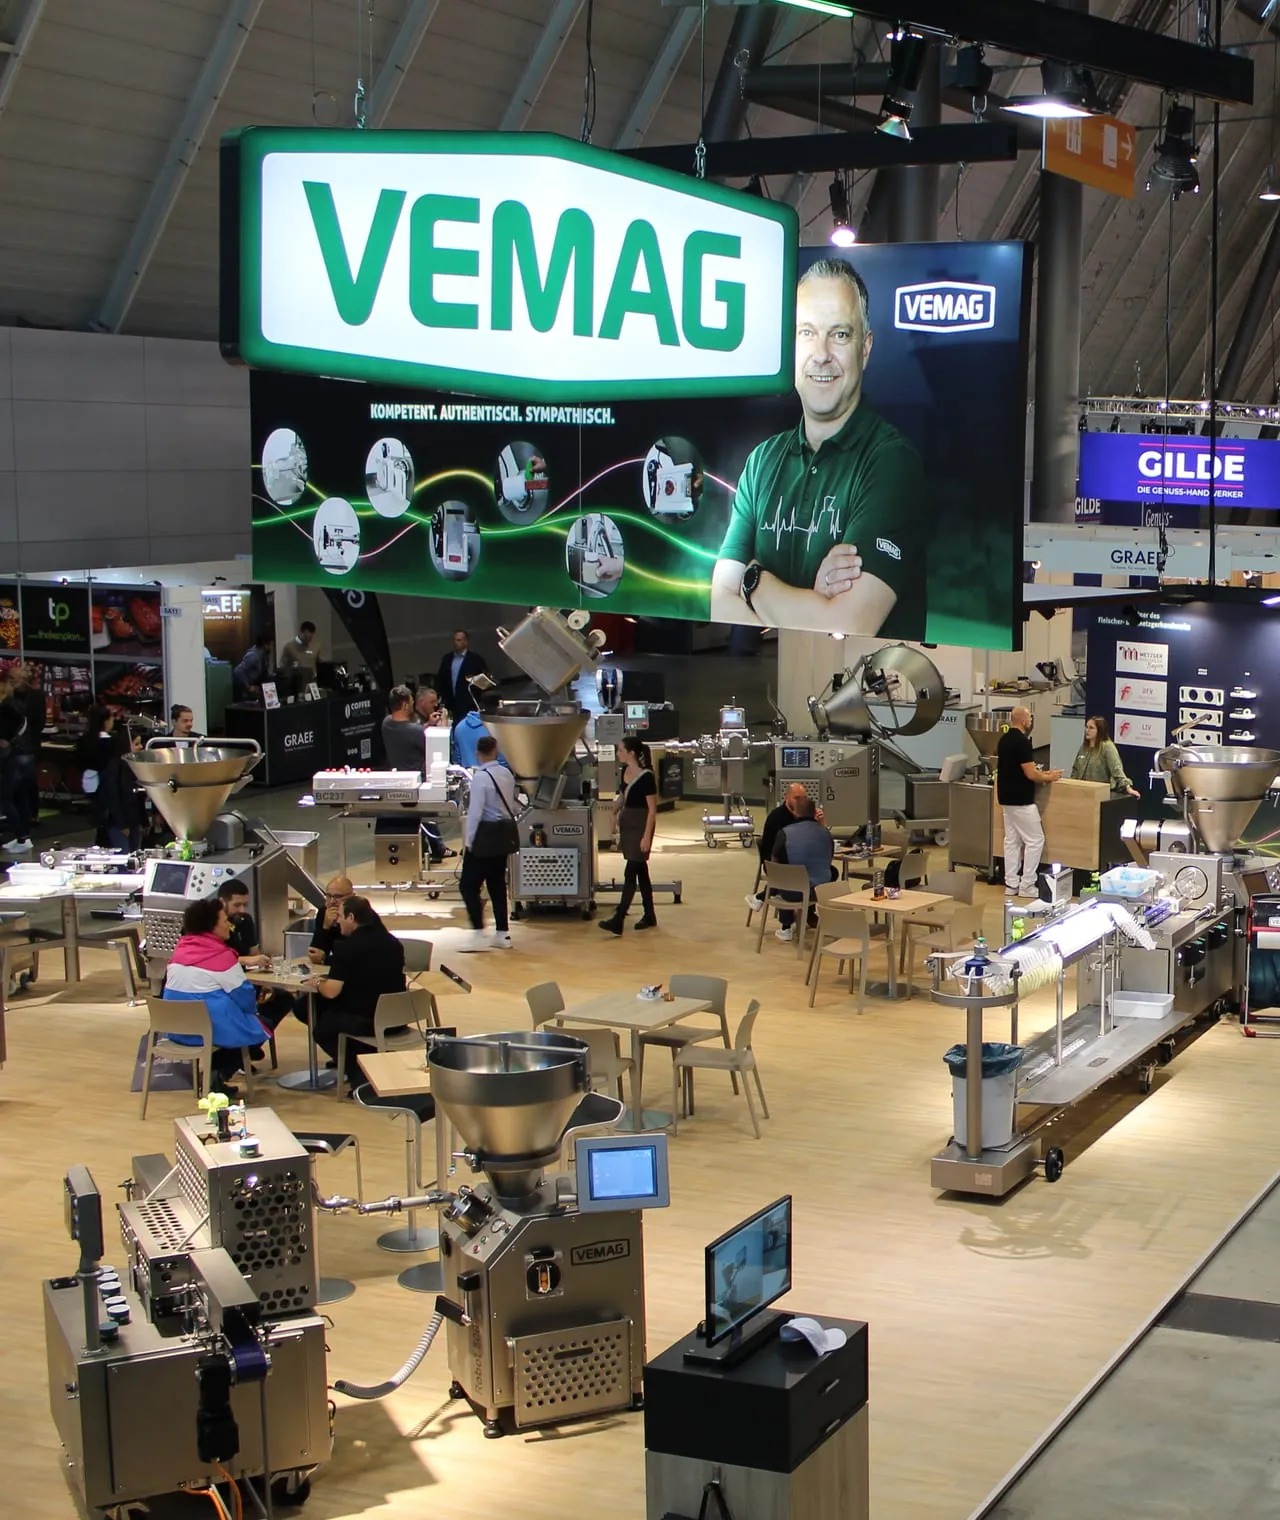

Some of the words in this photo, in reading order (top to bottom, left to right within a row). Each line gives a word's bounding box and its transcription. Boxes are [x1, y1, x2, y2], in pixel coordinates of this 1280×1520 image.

[302, 181, 746, 352] VEMAG
[904, 294, 984, 321] VEMAG
[370, 404, 437, 420] KOMPETENT.
[440, 405, 522, 422] AUTHENTISCH.
[525, 407, 615, 424] SYMPATHISCH.
[1138, 451, 1244, 481] GILDE
[1137, 486, 1150, 494] DIE
[1074, 497, 1101, 515] GILDE
[48, 598, 70, 627] tp
[350, 701, 371, 710] COFFEE
[575, 1243, 624, 1261] VEMAG
[473, 1351, 483, 1396] Robot
